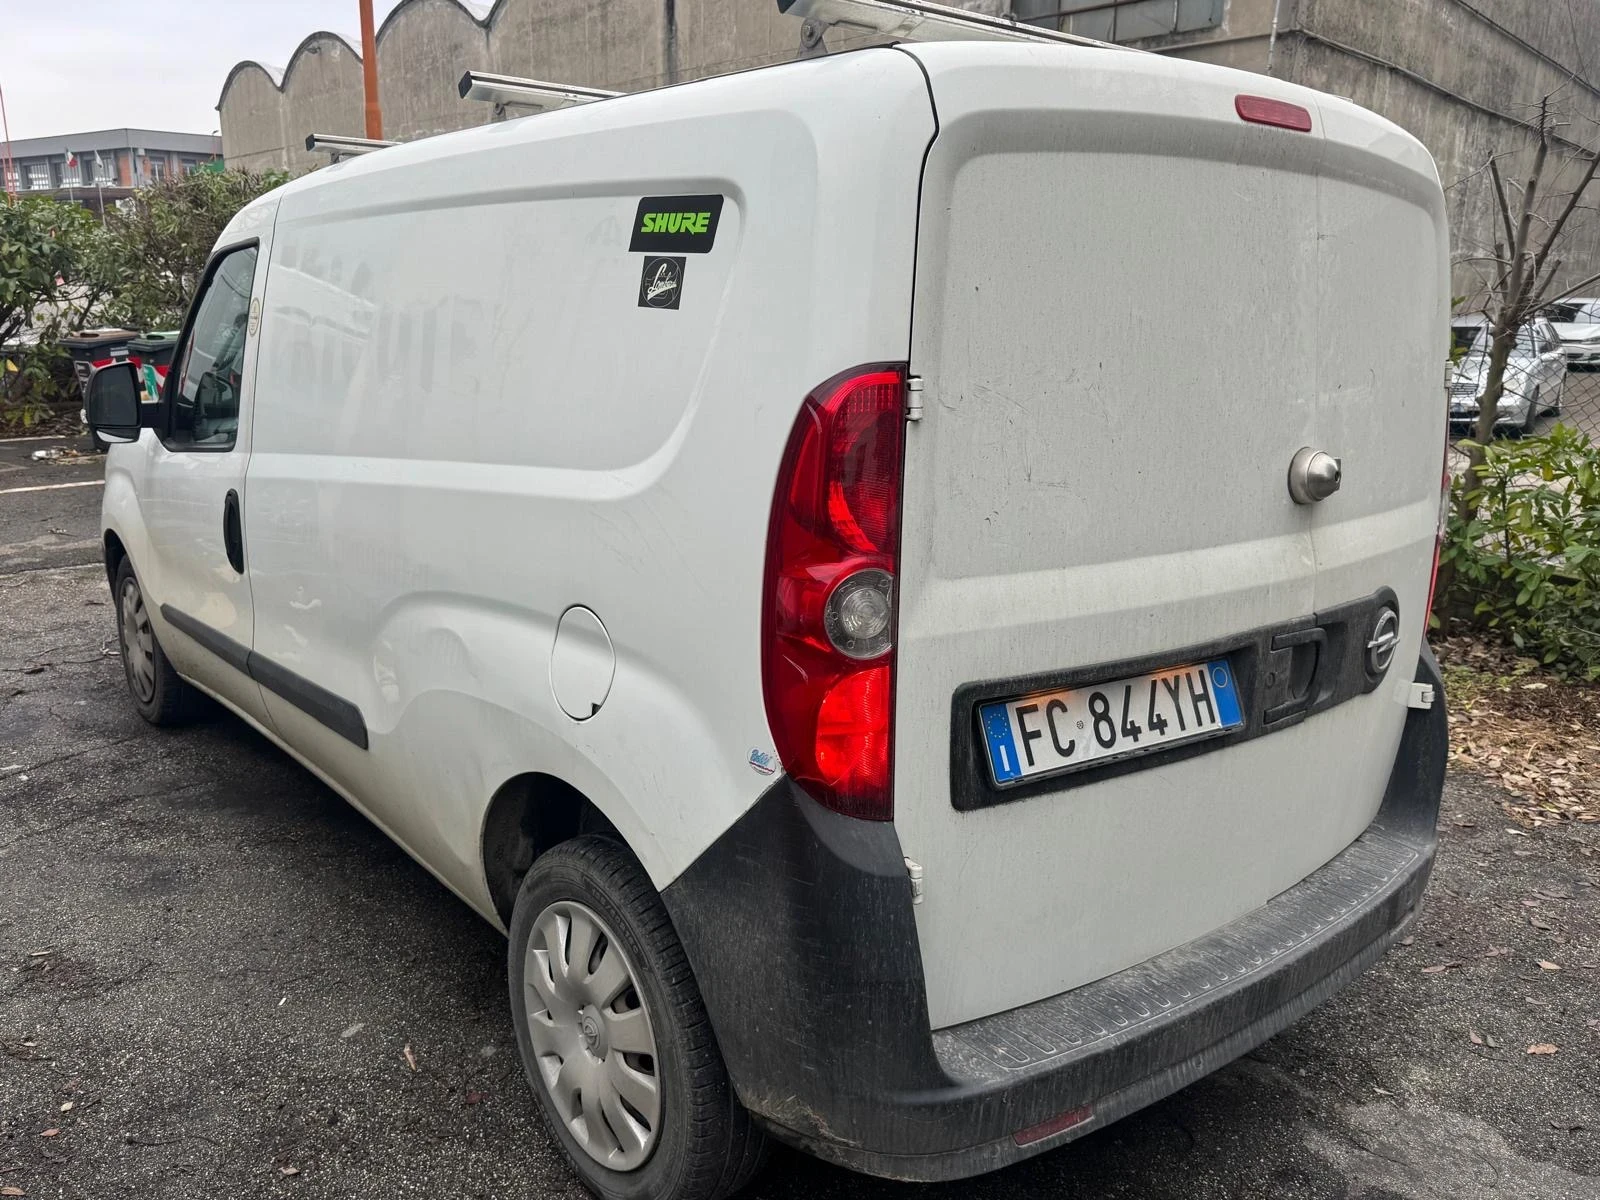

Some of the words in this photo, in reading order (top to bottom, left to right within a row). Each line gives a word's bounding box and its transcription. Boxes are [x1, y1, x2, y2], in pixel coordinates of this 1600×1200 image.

[641, 212, 711, 235] SHURE
[1015, 699, 1075, 767] FC
[1088, 669, 1216, 749] 844YH
